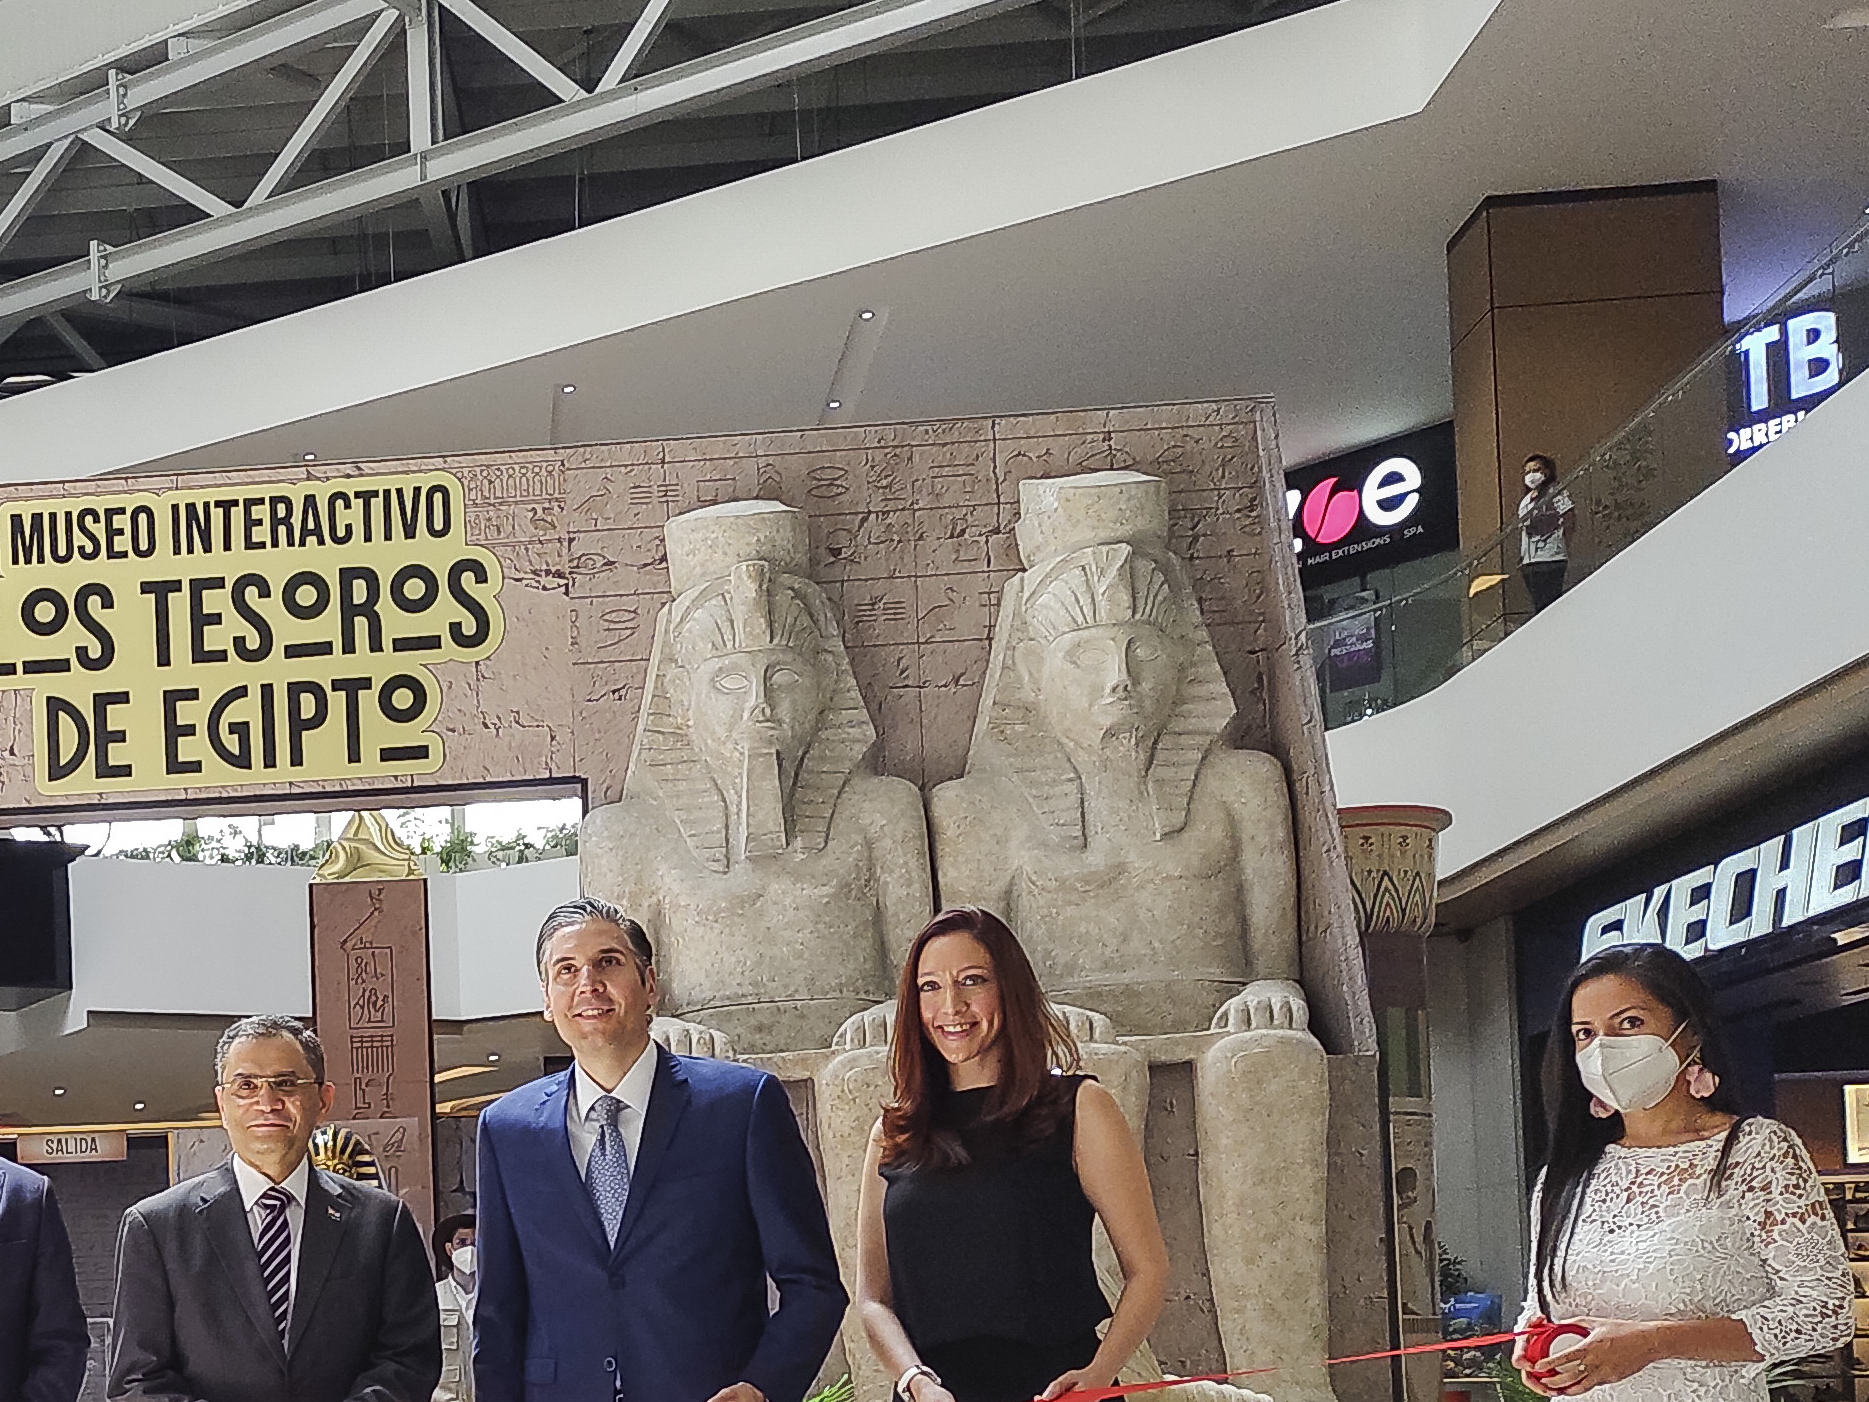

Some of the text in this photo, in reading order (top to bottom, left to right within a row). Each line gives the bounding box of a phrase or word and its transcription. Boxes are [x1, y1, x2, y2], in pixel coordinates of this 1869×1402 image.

[1735, 311, 1843, 413] TB
[10, 483, 451, 566] MUSEO INTERACTIVO
[1307, 552, 1330, 566] HAIR
[1331, 534, 1391, 560] EXTENSIONS
[1403, 524, 1425, 539] SPA
[140, 557, 491, 668] TESOROS
[45, 673, 429, 782] DE EGIPTO
[1579, 796, 1869, 966] SKECHE
[44, 1136, 99, 1156] SALIDA
